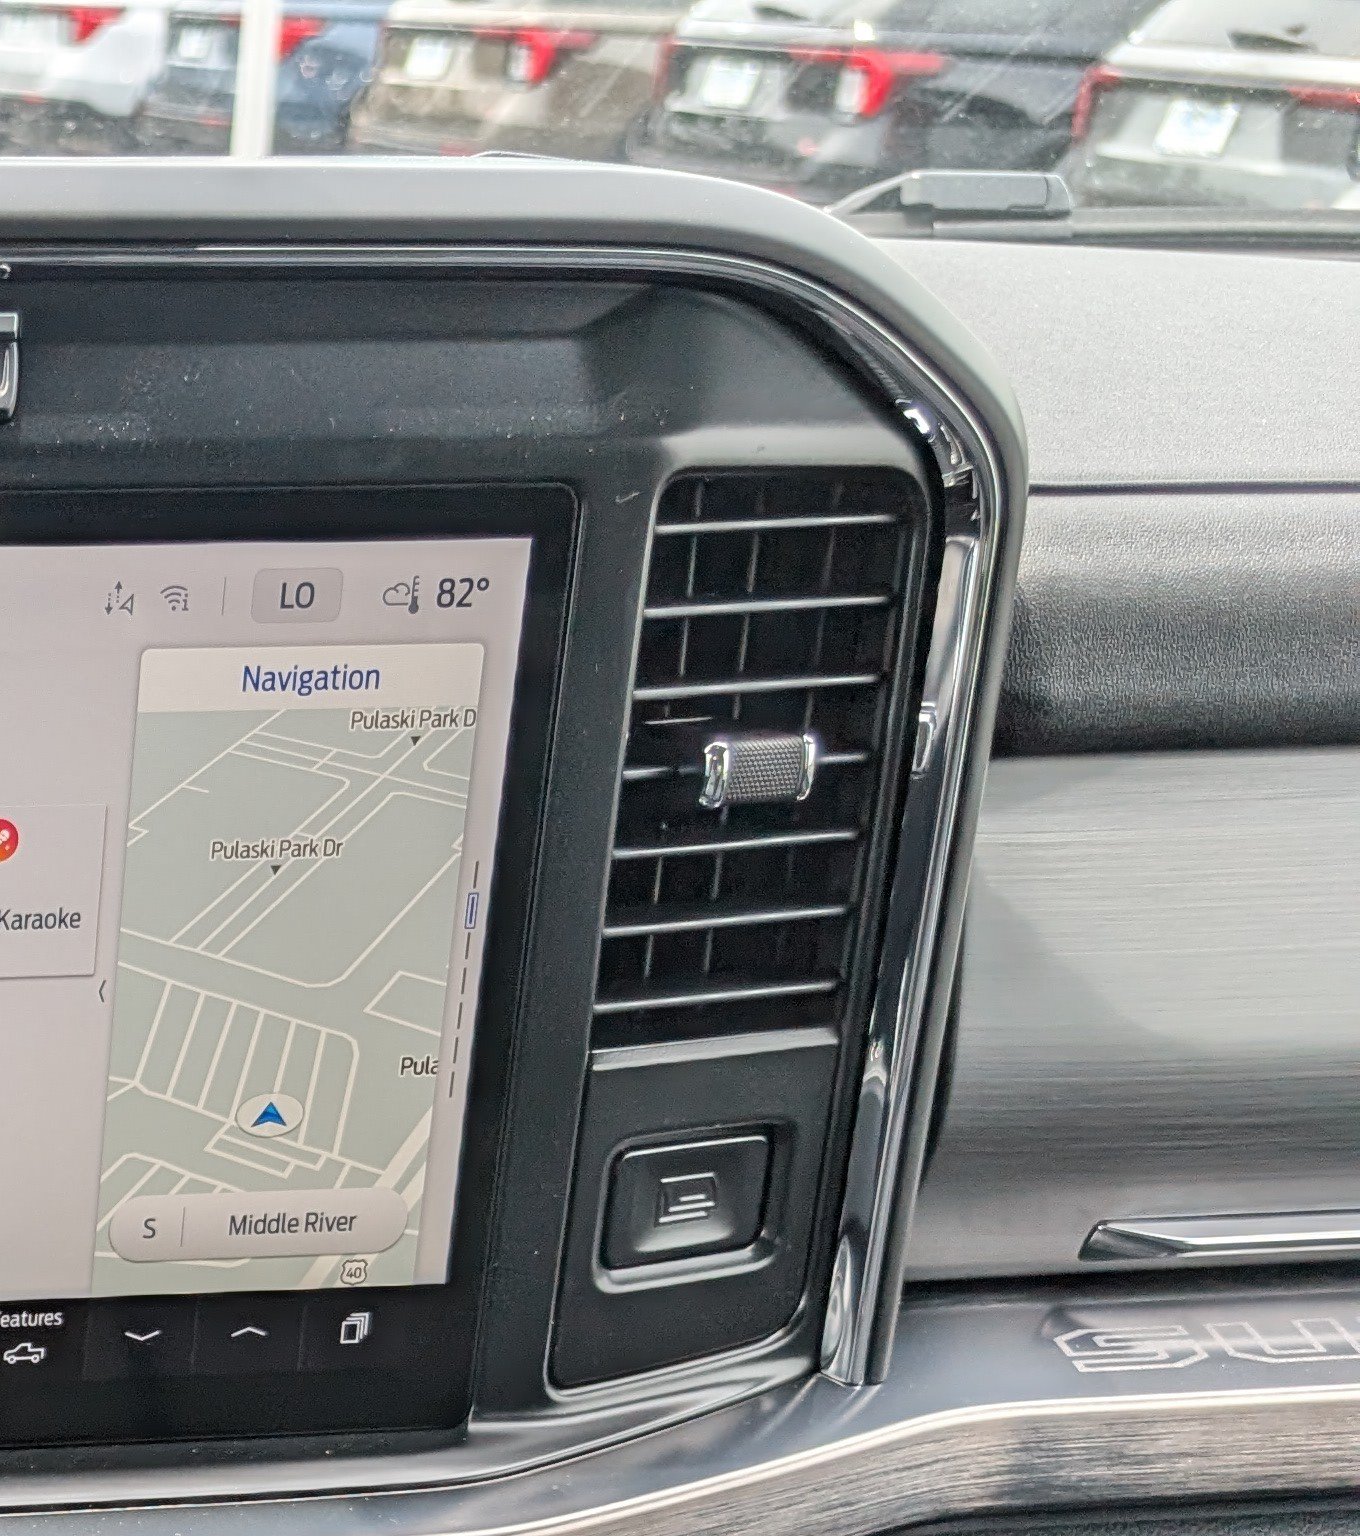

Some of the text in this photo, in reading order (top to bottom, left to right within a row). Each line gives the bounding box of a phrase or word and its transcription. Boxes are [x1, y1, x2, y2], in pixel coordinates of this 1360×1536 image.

[280, 581, 315, 610] LO
[436, 577, 490, 609] 82°
[242, 664, 381, 696] Navigation
[350, 709, 415, 730] Pulaski
[418, 708, 459, 728] Park
[211, 839, 344, 860] Pulaski Park Dr
[142, 1218, 157, 1239] S
[228, 1211, 358, 1236] Middle River
[346, 1266, 362, 1279] 40
